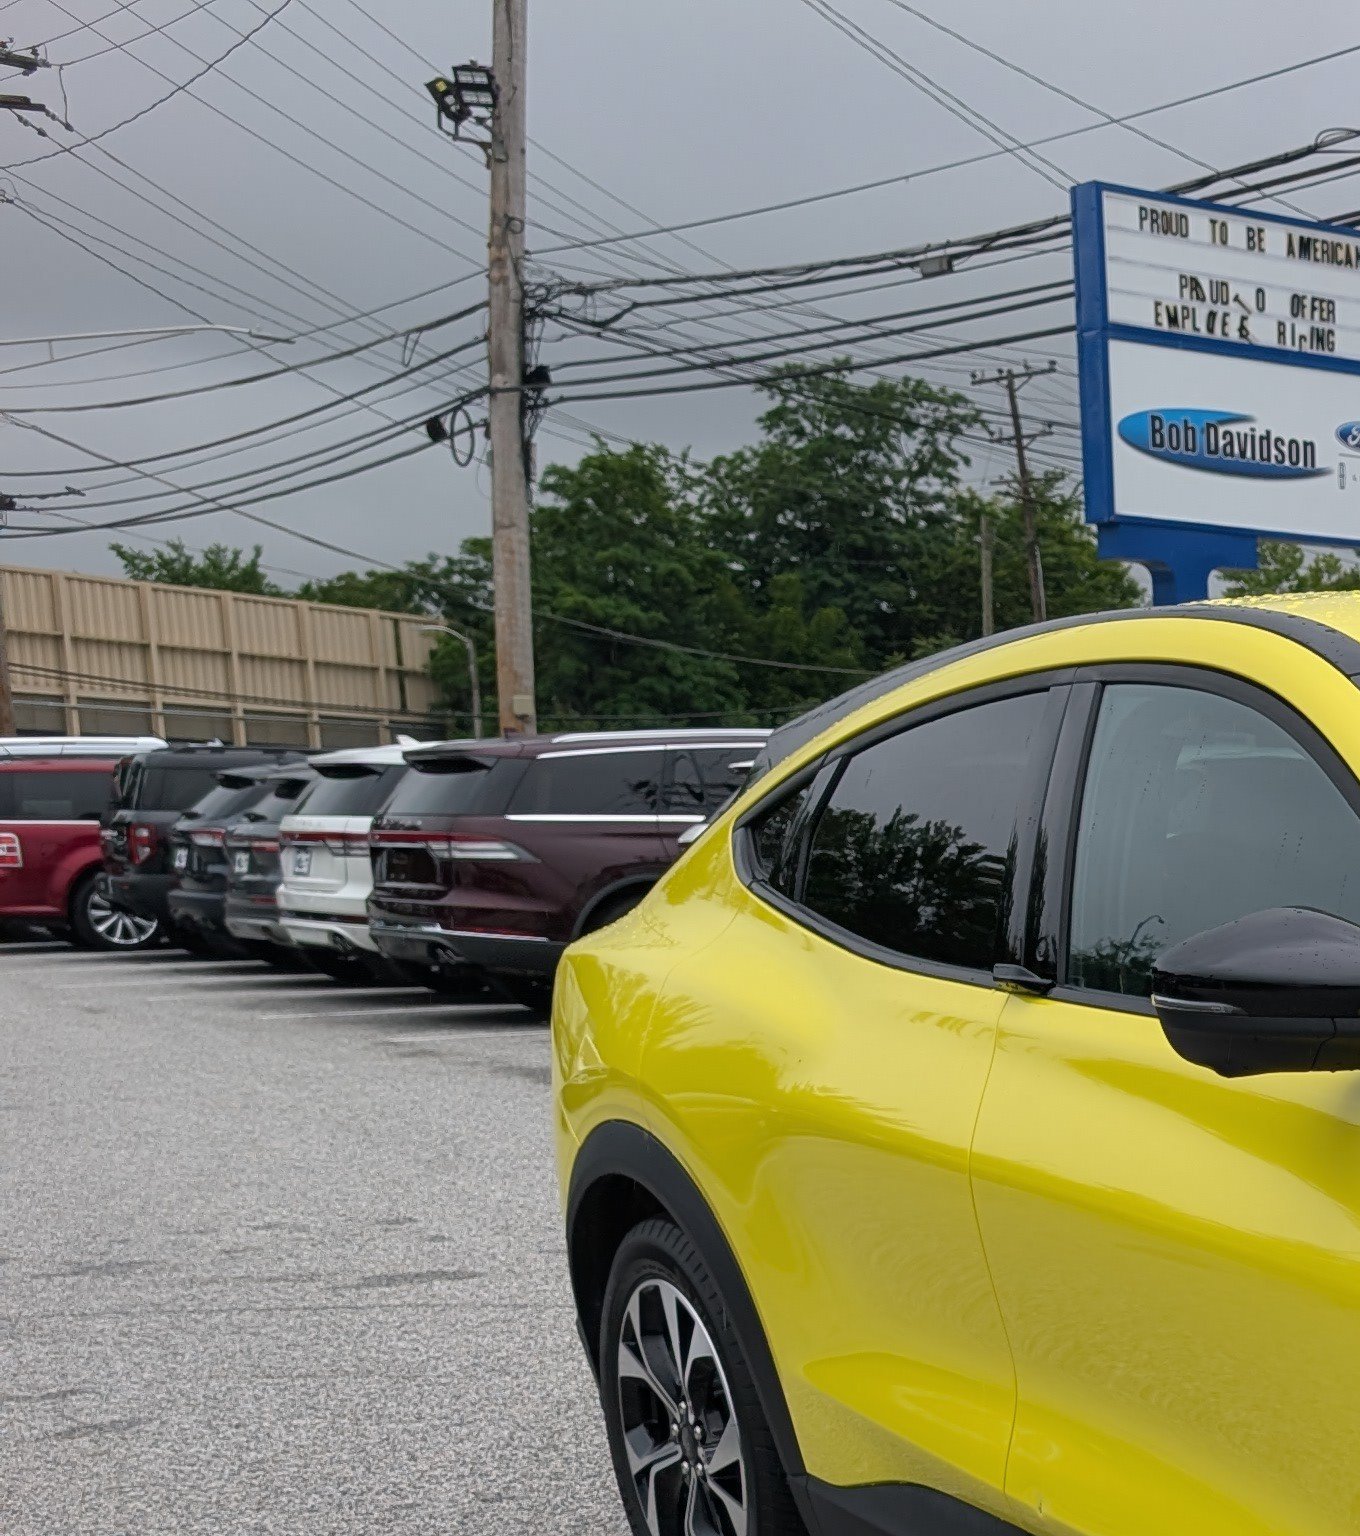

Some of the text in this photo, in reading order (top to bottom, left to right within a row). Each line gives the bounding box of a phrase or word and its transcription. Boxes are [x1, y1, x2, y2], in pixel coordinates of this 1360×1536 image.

[1138, 206, 1190, 238] PROUD
[1209, 218, 1229, 246] TO
[1246, 226, 1266, 252] BE
[1290, 293, 1336, 323] OFFER
[1151, 415, 1315, 468] Bob Davidson
